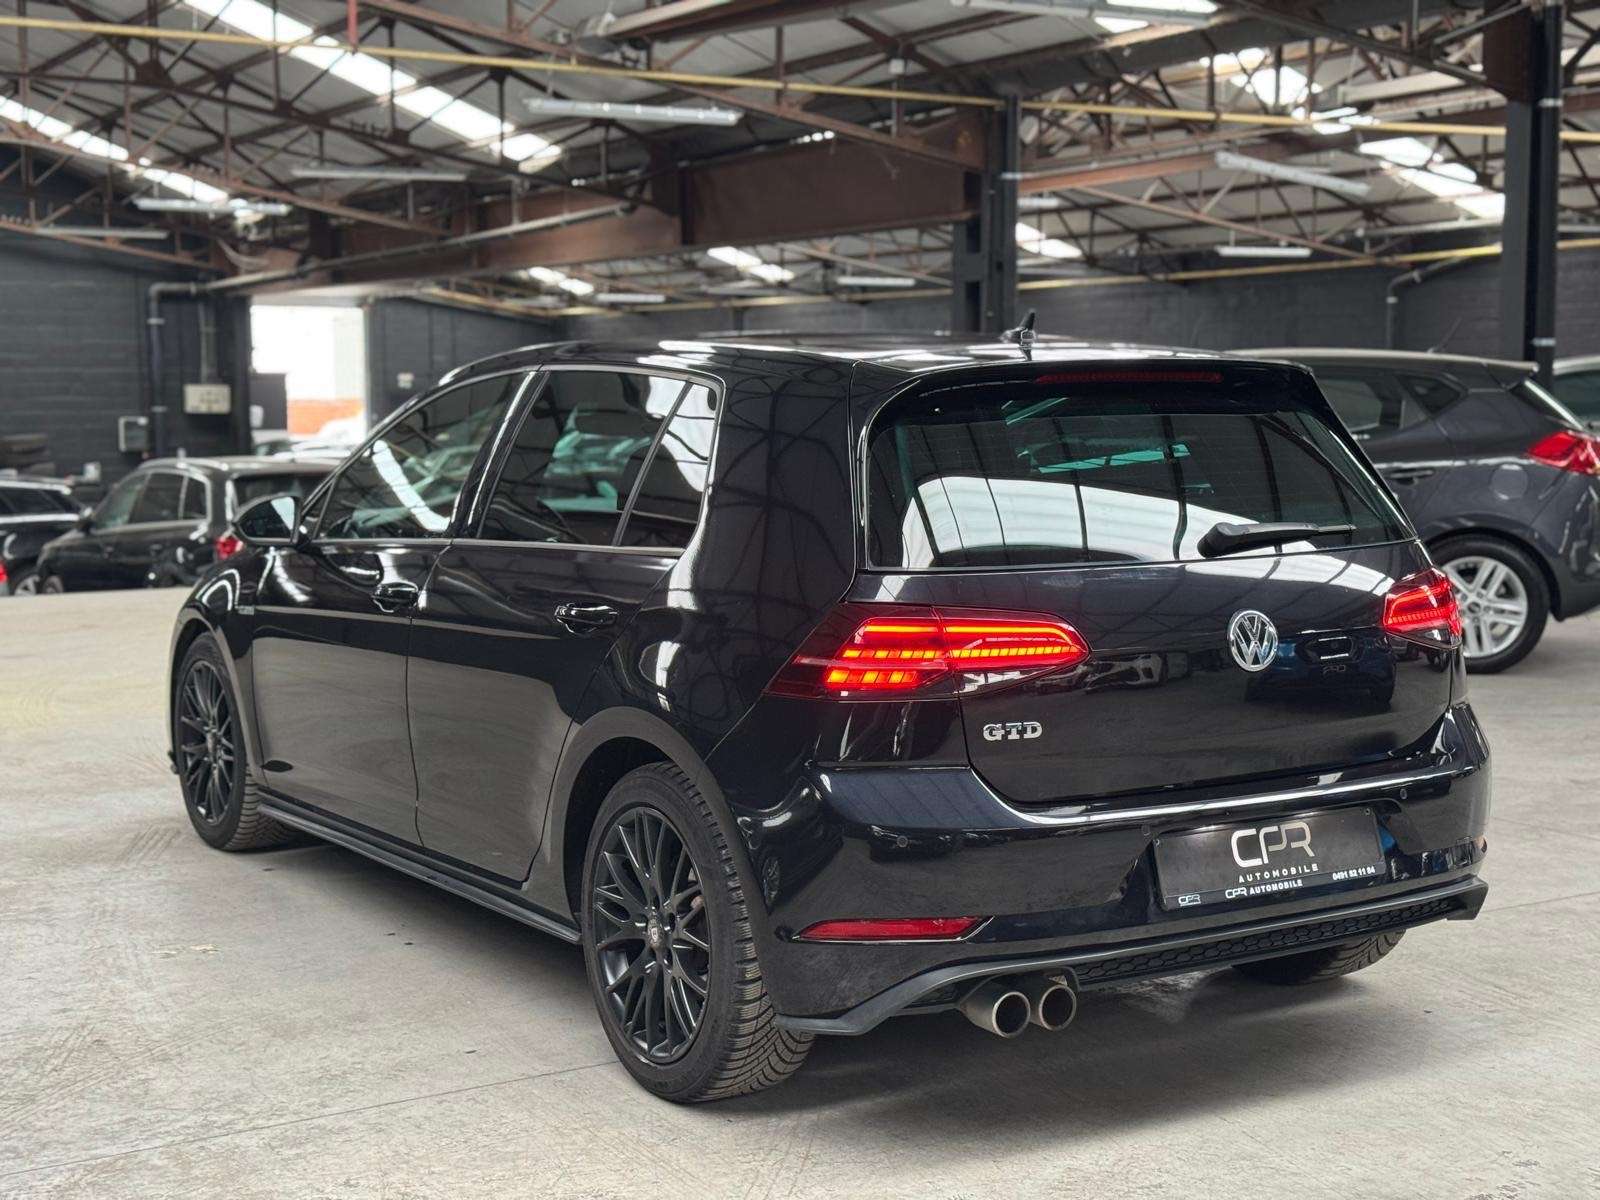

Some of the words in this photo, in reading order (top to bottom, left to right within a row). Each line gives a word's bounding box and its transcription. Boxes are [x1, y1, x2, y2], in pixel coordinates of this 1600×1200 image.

[983, 721, 1042, 741] GTD
[1231, 821, 1315, 868] CPR
[1238, 863, 1319, 883] AUTOMOBILE
[1225, 887, 1247, 899] CPR
[1249, 879, 1303, 896] AUTOMOBILE
